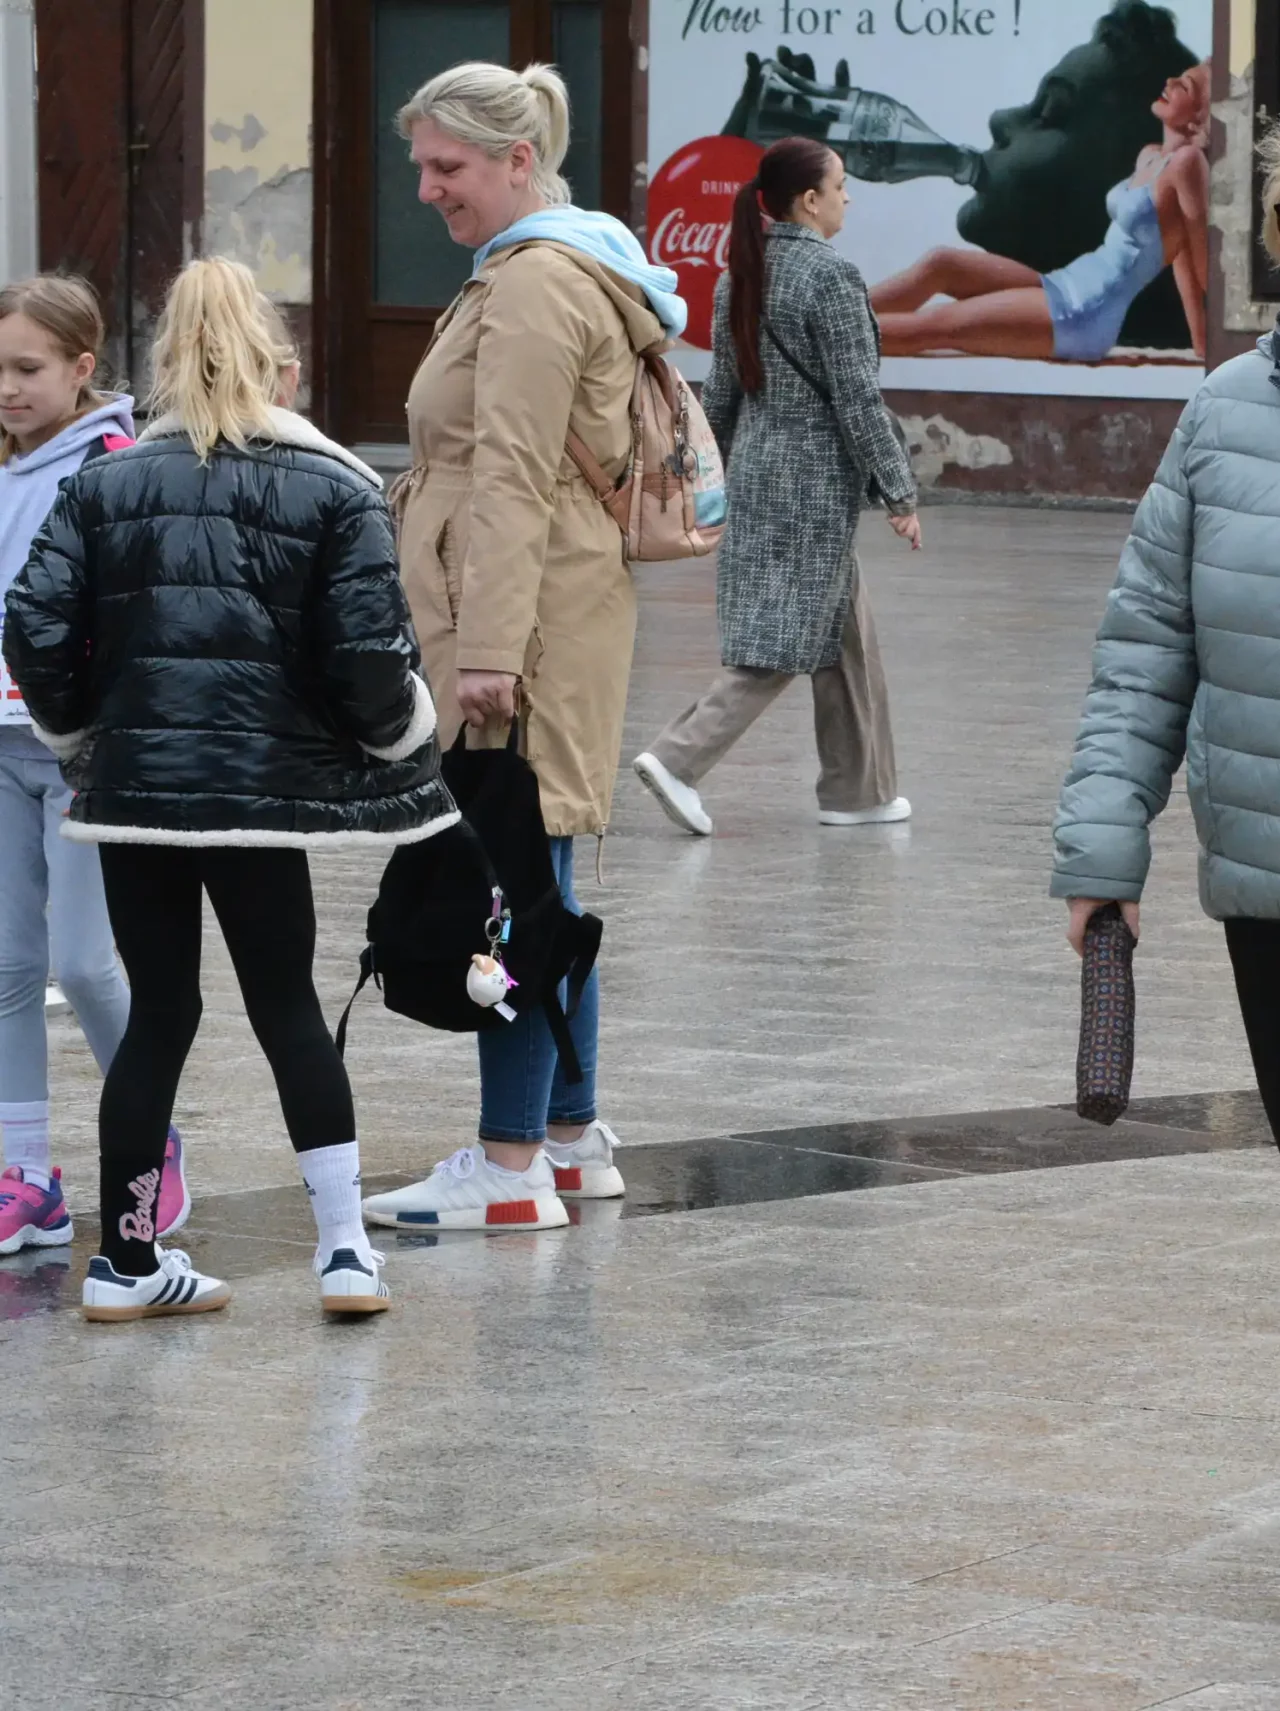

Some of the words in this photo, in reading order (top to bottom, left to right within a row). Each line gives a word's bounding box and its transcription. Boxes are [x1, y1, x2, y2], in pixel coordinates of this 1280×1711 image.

[681, 0, 762, 40] Now
[779, 0, 841, 35] for
[857, 8, 875, 35] a
[895, 0, 996, 36] Coke
[119, 1168, 160, 1242] Barbie
